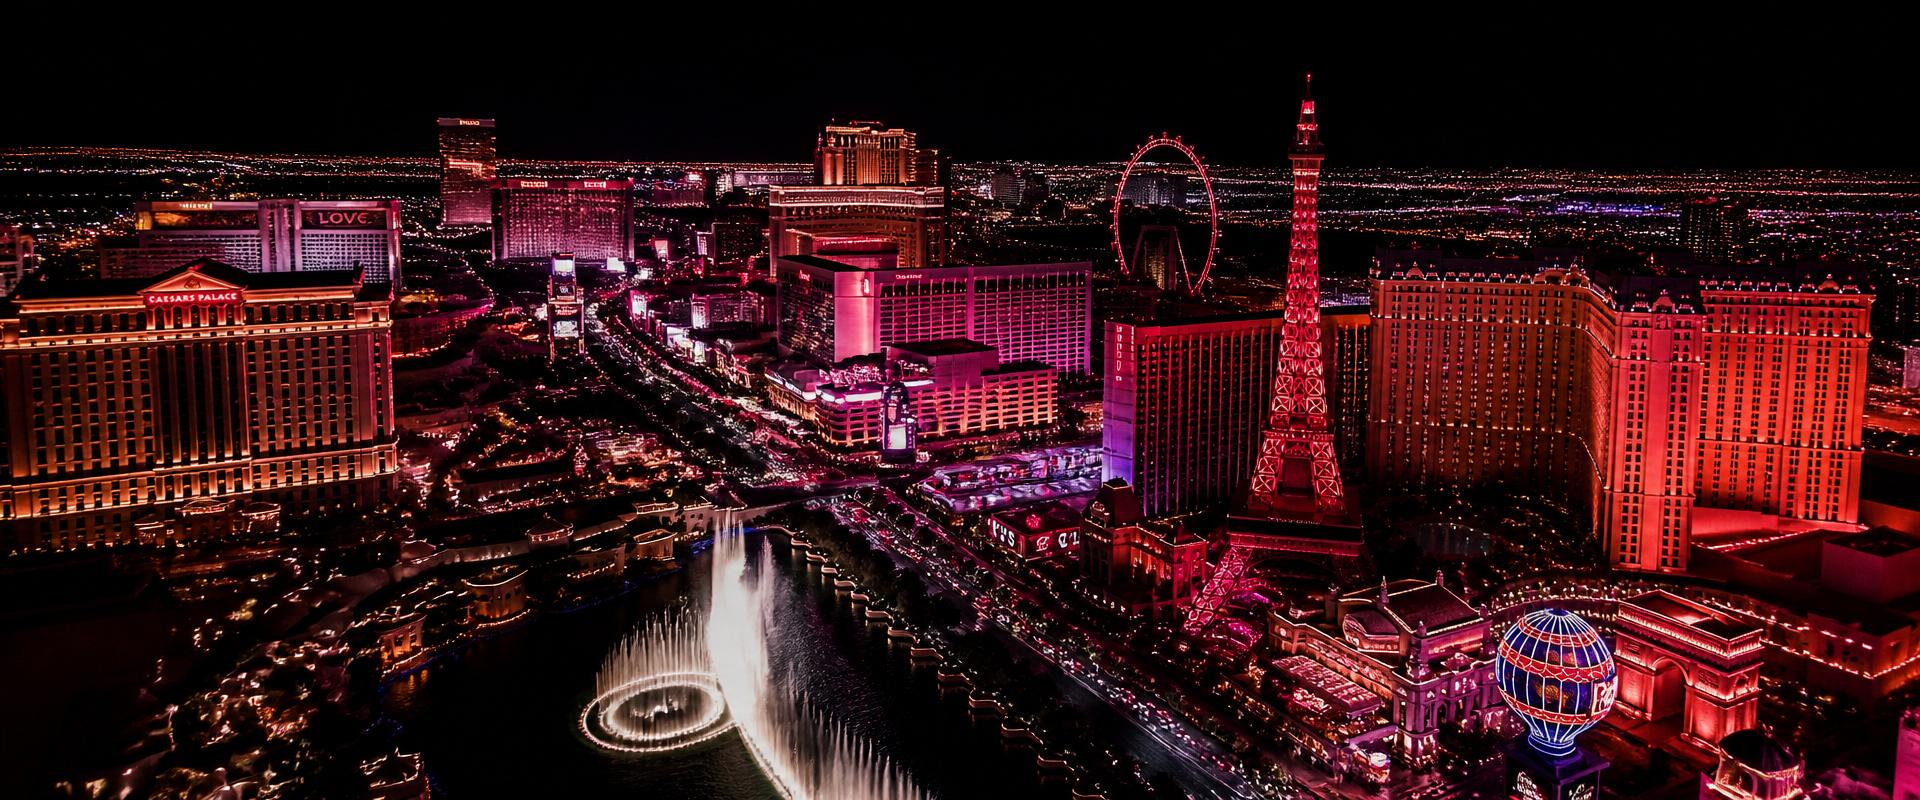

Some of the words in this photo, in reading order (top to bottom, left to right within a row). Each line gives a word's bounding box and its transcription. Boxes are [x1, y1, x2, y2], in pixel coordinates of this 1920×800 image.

[319, 212, 368, 224] LOVE
[149, 294, 196, 304] CAESARS
[198, 292, 238, 302] PALACE
